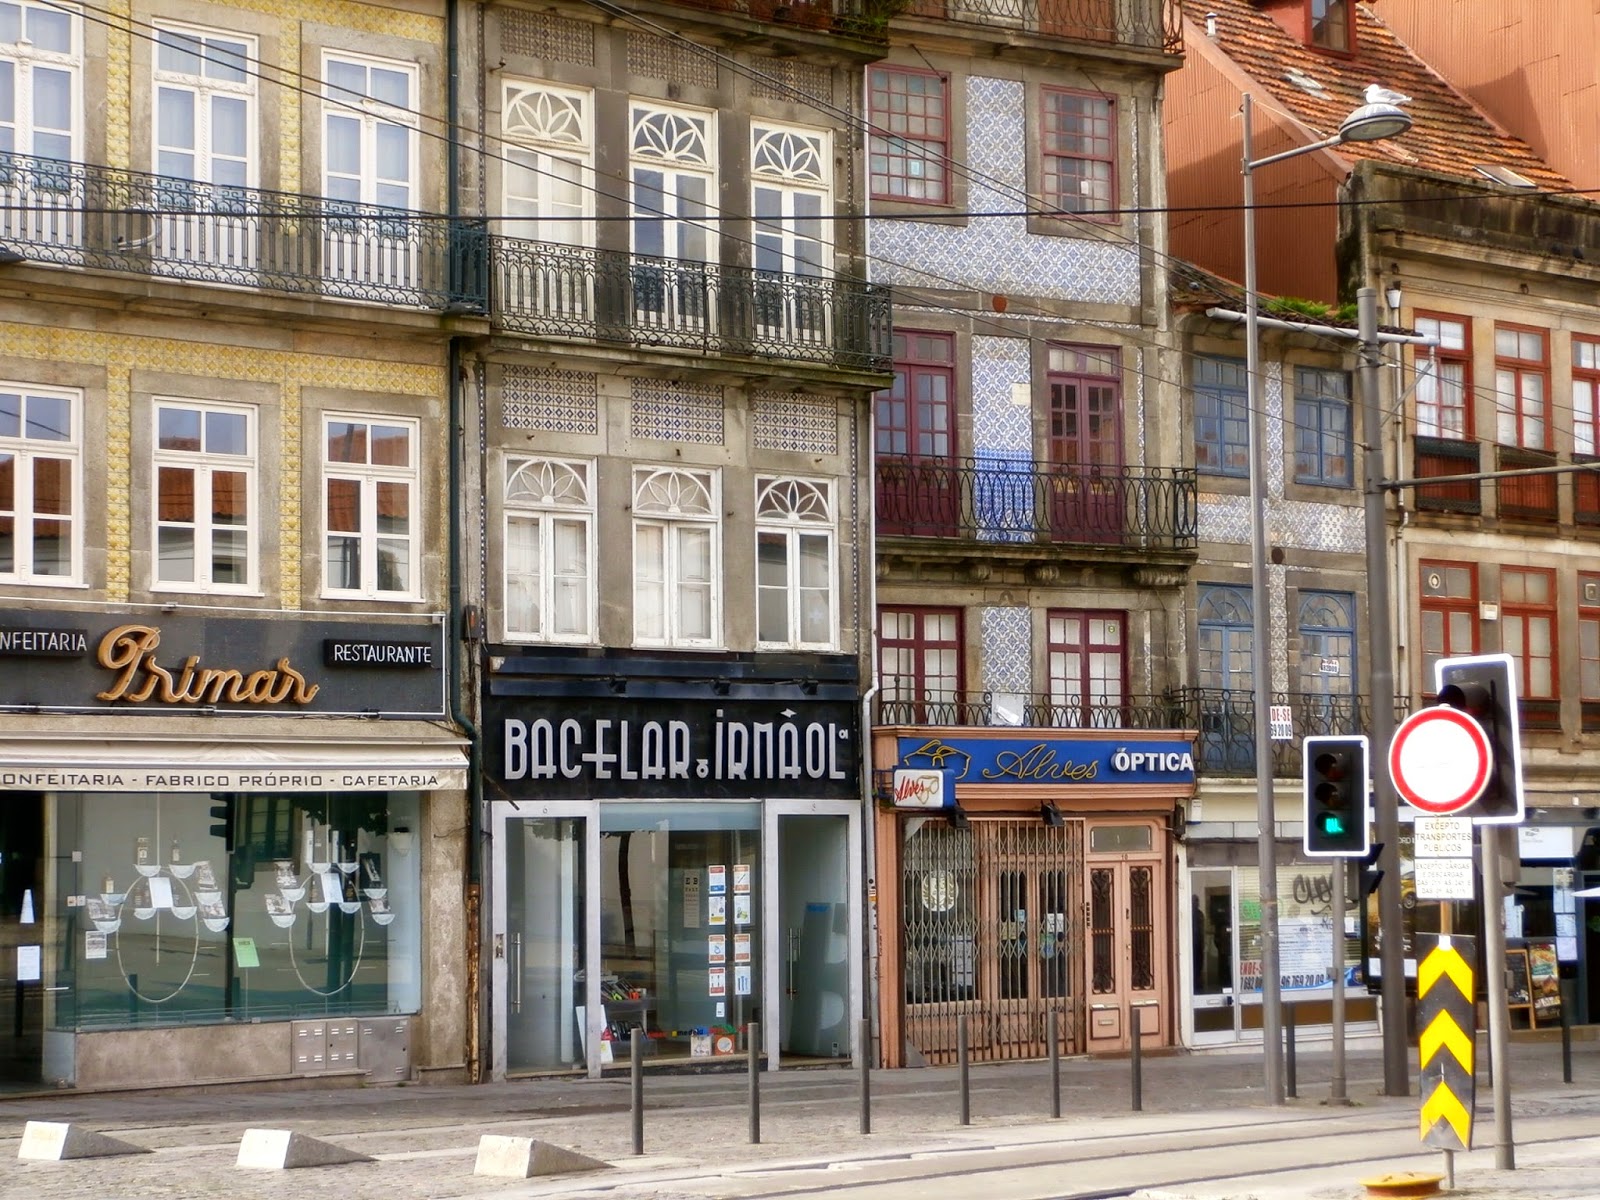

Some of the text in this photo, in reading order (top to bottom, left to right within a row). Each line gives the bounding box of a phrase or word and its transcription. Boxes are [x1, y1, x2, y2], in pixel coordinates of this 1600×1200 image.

[334, 644, 432, 663] RESTAURANTE
[504, 718, 690, 779] BACELAR
[982, 743, 1099, 780] Alves
[1111, 747, 1195, 772] ÓPTICA
[145, 775, 230, 787] FABRICO
[239, 772, 323, 787] PRÓPRIO
[342, 775, 439, 787] CAFETARIA
[1424, 821, 1460, 830] EXCEPTO
[1415, 832, 1472, 841] TRANSPORTES
